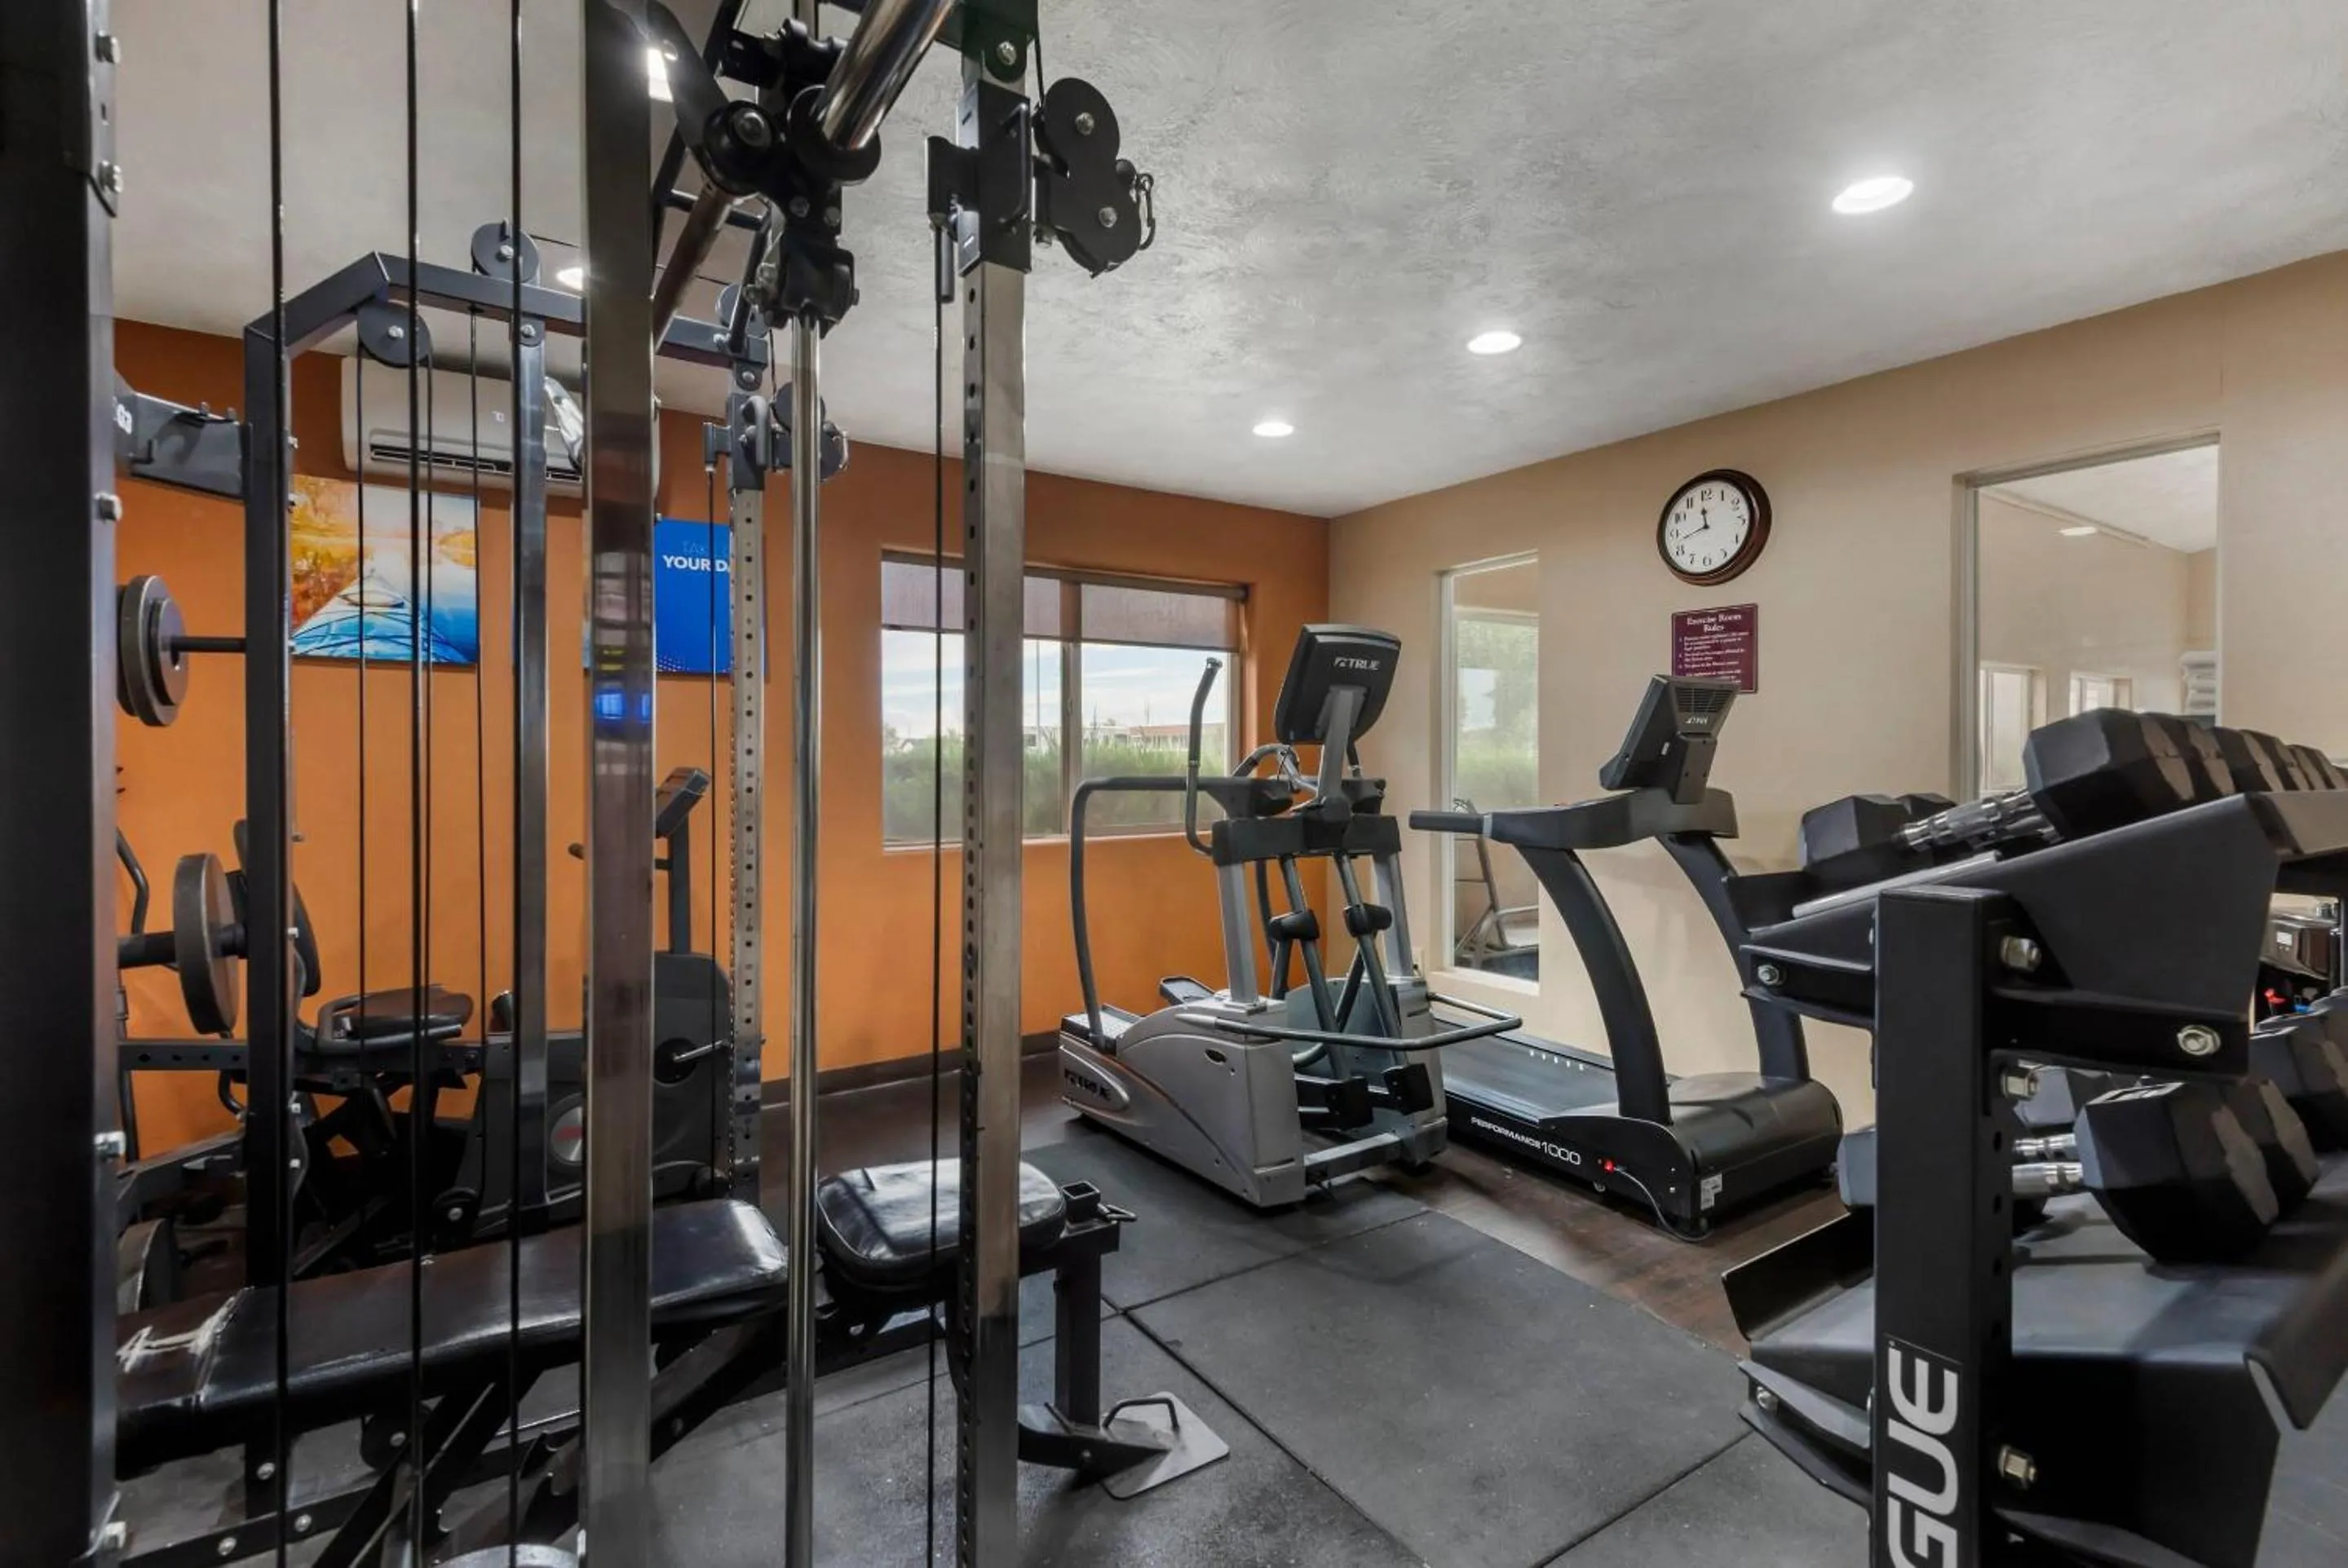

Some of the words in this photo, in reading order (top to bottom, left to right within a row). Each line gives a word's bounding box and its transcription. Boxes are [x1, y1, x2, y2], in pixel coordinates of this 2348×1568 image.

[1701, 488, 1713, 501] 12
[662, 554, 712, 572] YOUR
[714, 559, 730, 572] D
[1470, 1116, 1541, 1150] PERFORMANCE
[1541, 1141, 1581, 1166] 1000
